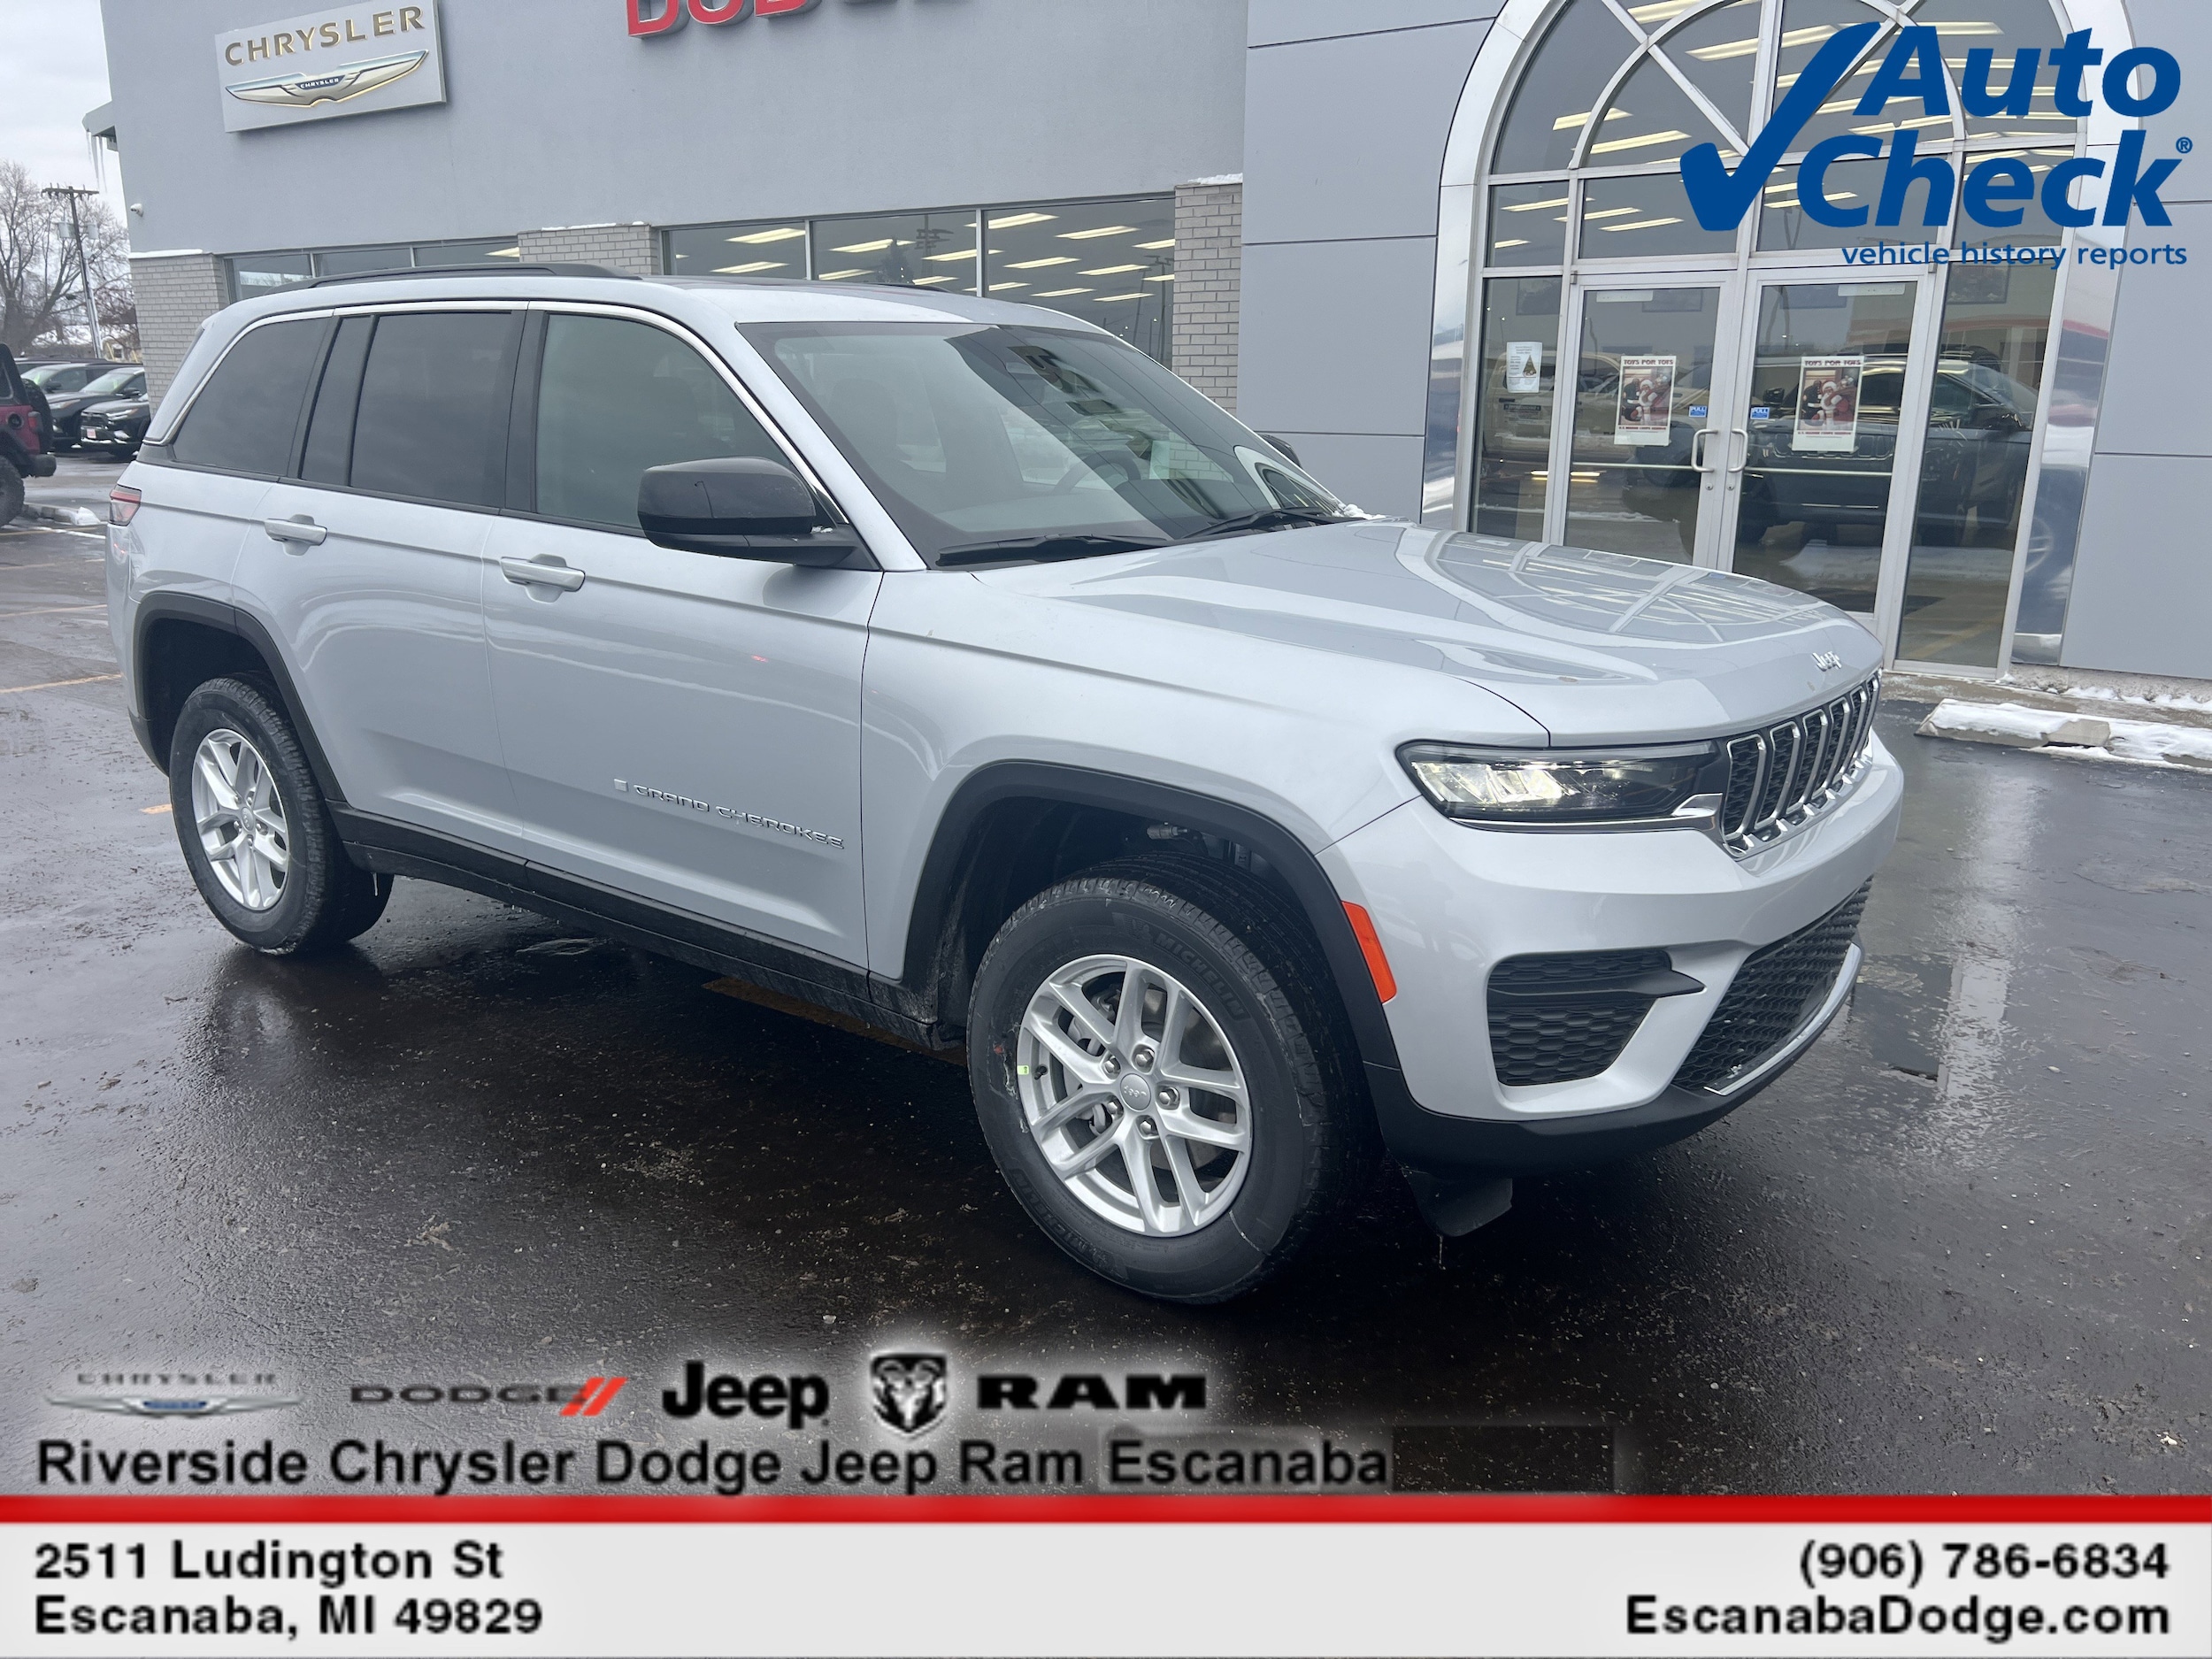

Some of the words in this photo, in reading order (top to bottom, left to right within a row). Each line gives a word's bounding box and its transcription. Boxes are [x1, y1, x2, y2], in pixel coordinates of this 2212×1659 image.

[225, 6, 425, 65] CHRYSLER
[300, 78, 340, 88] CHRYSLER
[634, 785, 710, 811] GRAND
[716, 806, 844, 849] CHEROKEE
[1155, 932, 1245, 1016] MICHELIN
